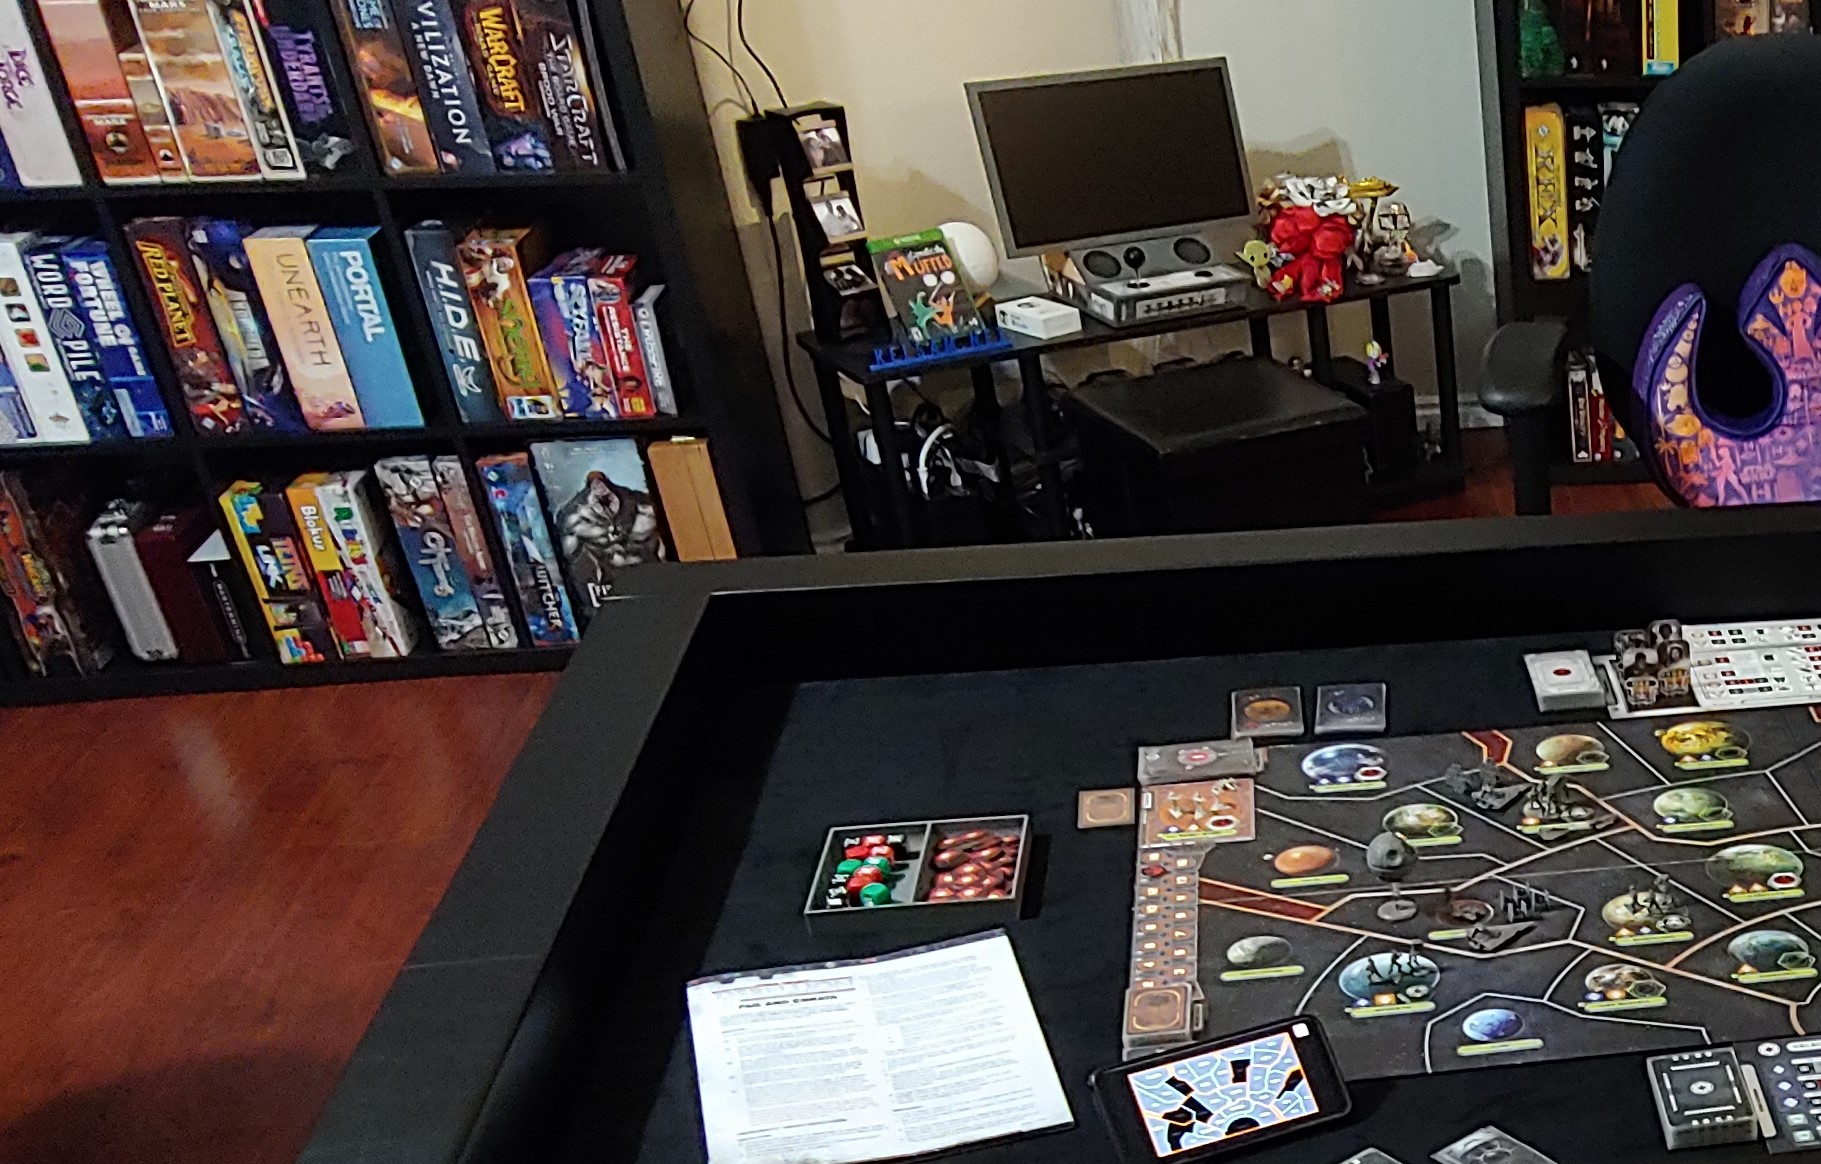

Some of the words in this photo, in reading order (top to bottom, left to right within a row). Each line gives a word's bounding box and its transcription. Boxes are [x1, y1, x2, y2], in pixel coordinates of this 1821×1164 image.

[0, 62, 23, 110] ORGE
[412, 34, 430, 60] NEW
[422, 64, 441, 99] DAWN
[479, 7, 526, 113] WARCRAFT
[538, 62, 556, 107] BROOD
[548, 31, 598, 166] STARCRAFT
[1535, 146, 1558, 227] REX
[90, 261, 125, 321] WHEEL
[149, 245, 170, 281] RED
[30, 253, 73, 308] WORD
[62, 339, 101, 382] PILE
[68, 261, 117, 347] FORTUNE
[159, 281, 192, 343] PLANET
[276, 253, 332, 366] UNEARTH
[339, 251, 385, 343] PORTAL
[301, 504, 327, 552] Blokus
[255, 544, 283, 589] LINK
[270, 535, 311, 591] TETRIS
